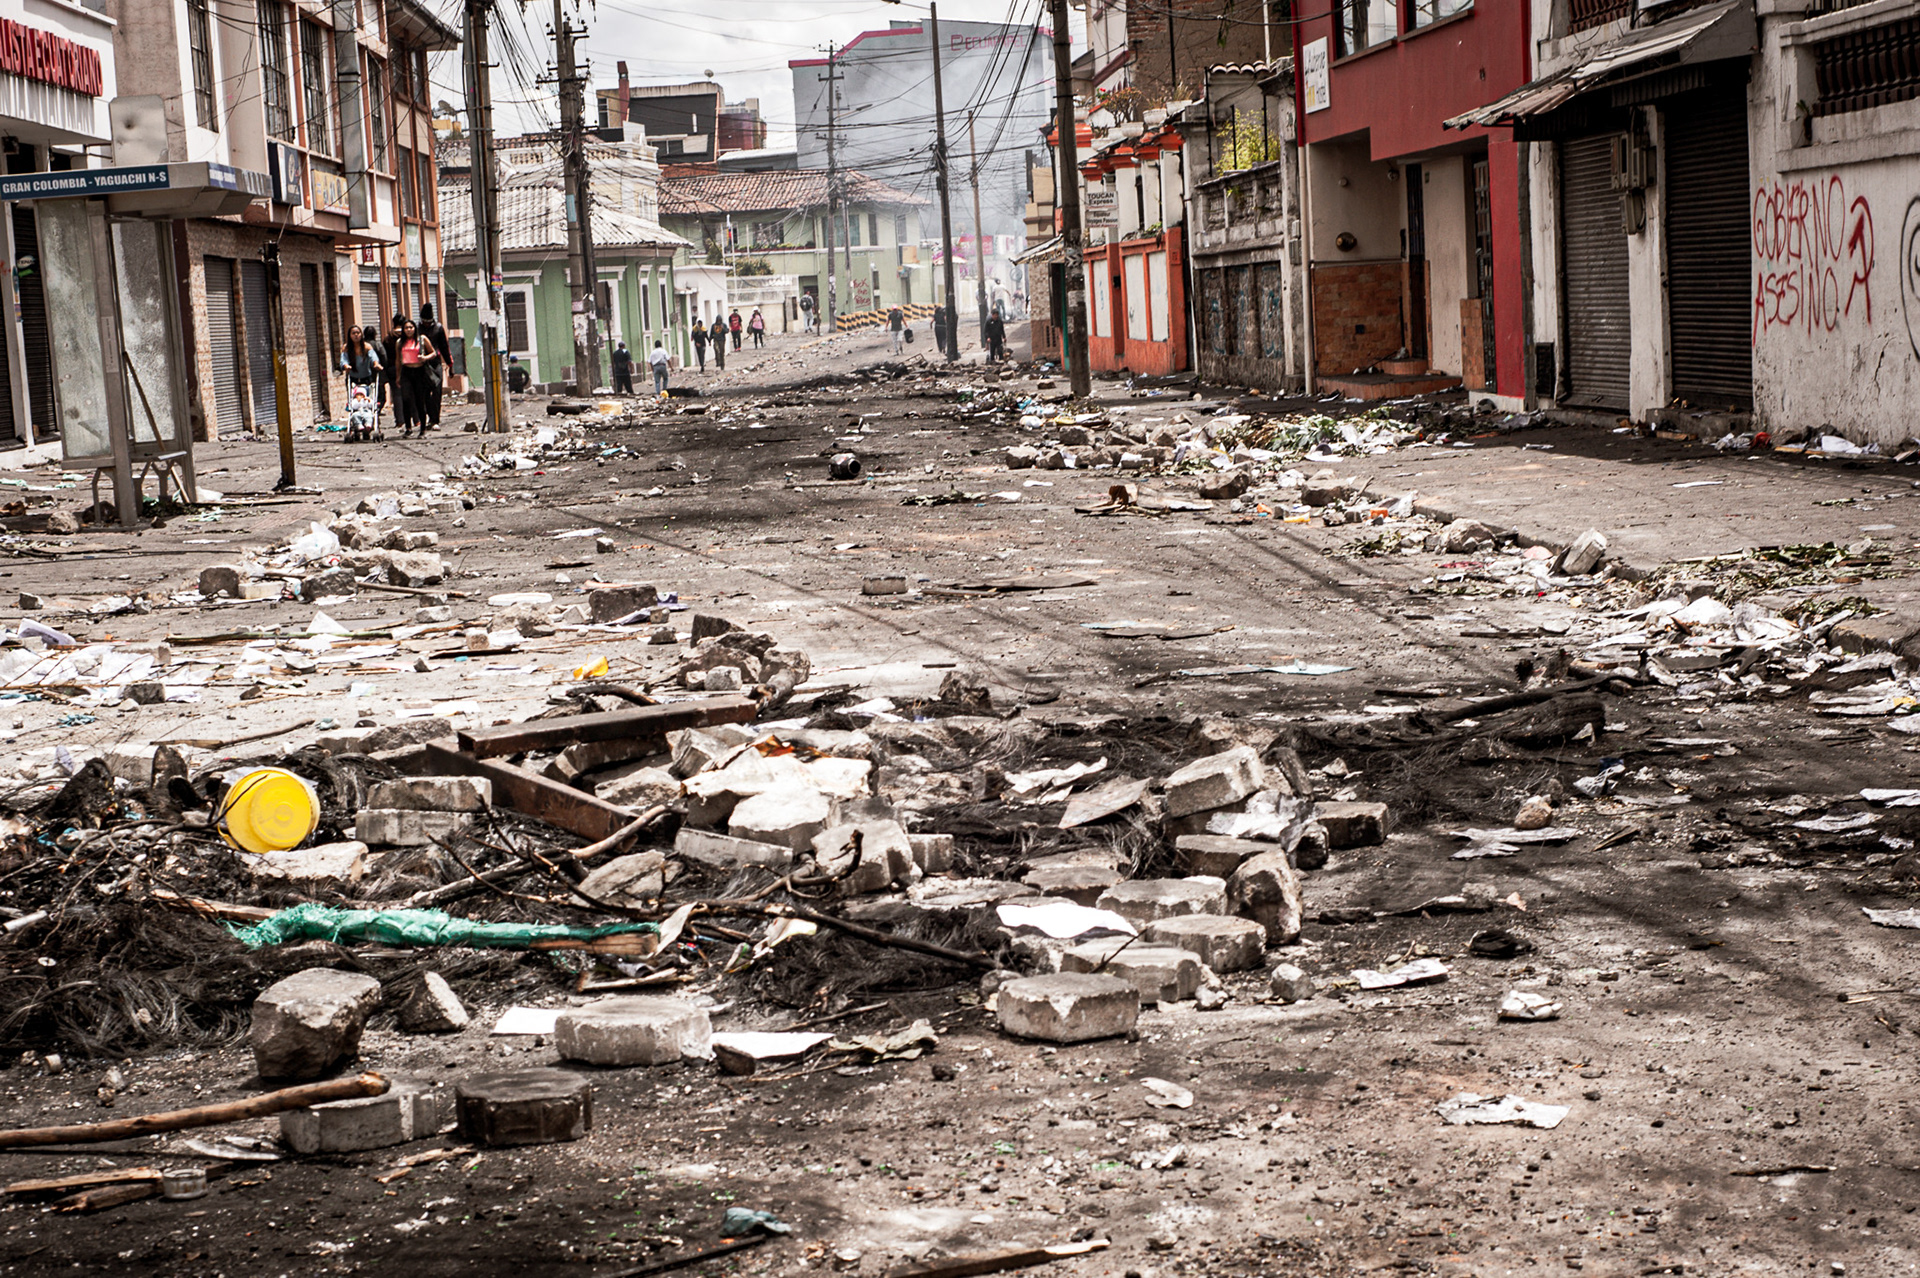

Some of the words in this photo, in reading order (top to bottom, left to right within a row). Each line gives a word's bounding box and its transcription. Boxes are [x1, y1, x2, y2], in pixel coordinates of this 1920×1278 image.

[2, 182, 31, 194] GRAN
[33, 177, 87, 191] COLOMBIA
[94, 173, 147, 187] YAGUACHI
[148, 171, 167, 183] N-S
[1754, 175, 1846, 270] GOBIERNO
[1752, 264, 1839, 347] ASESINO
